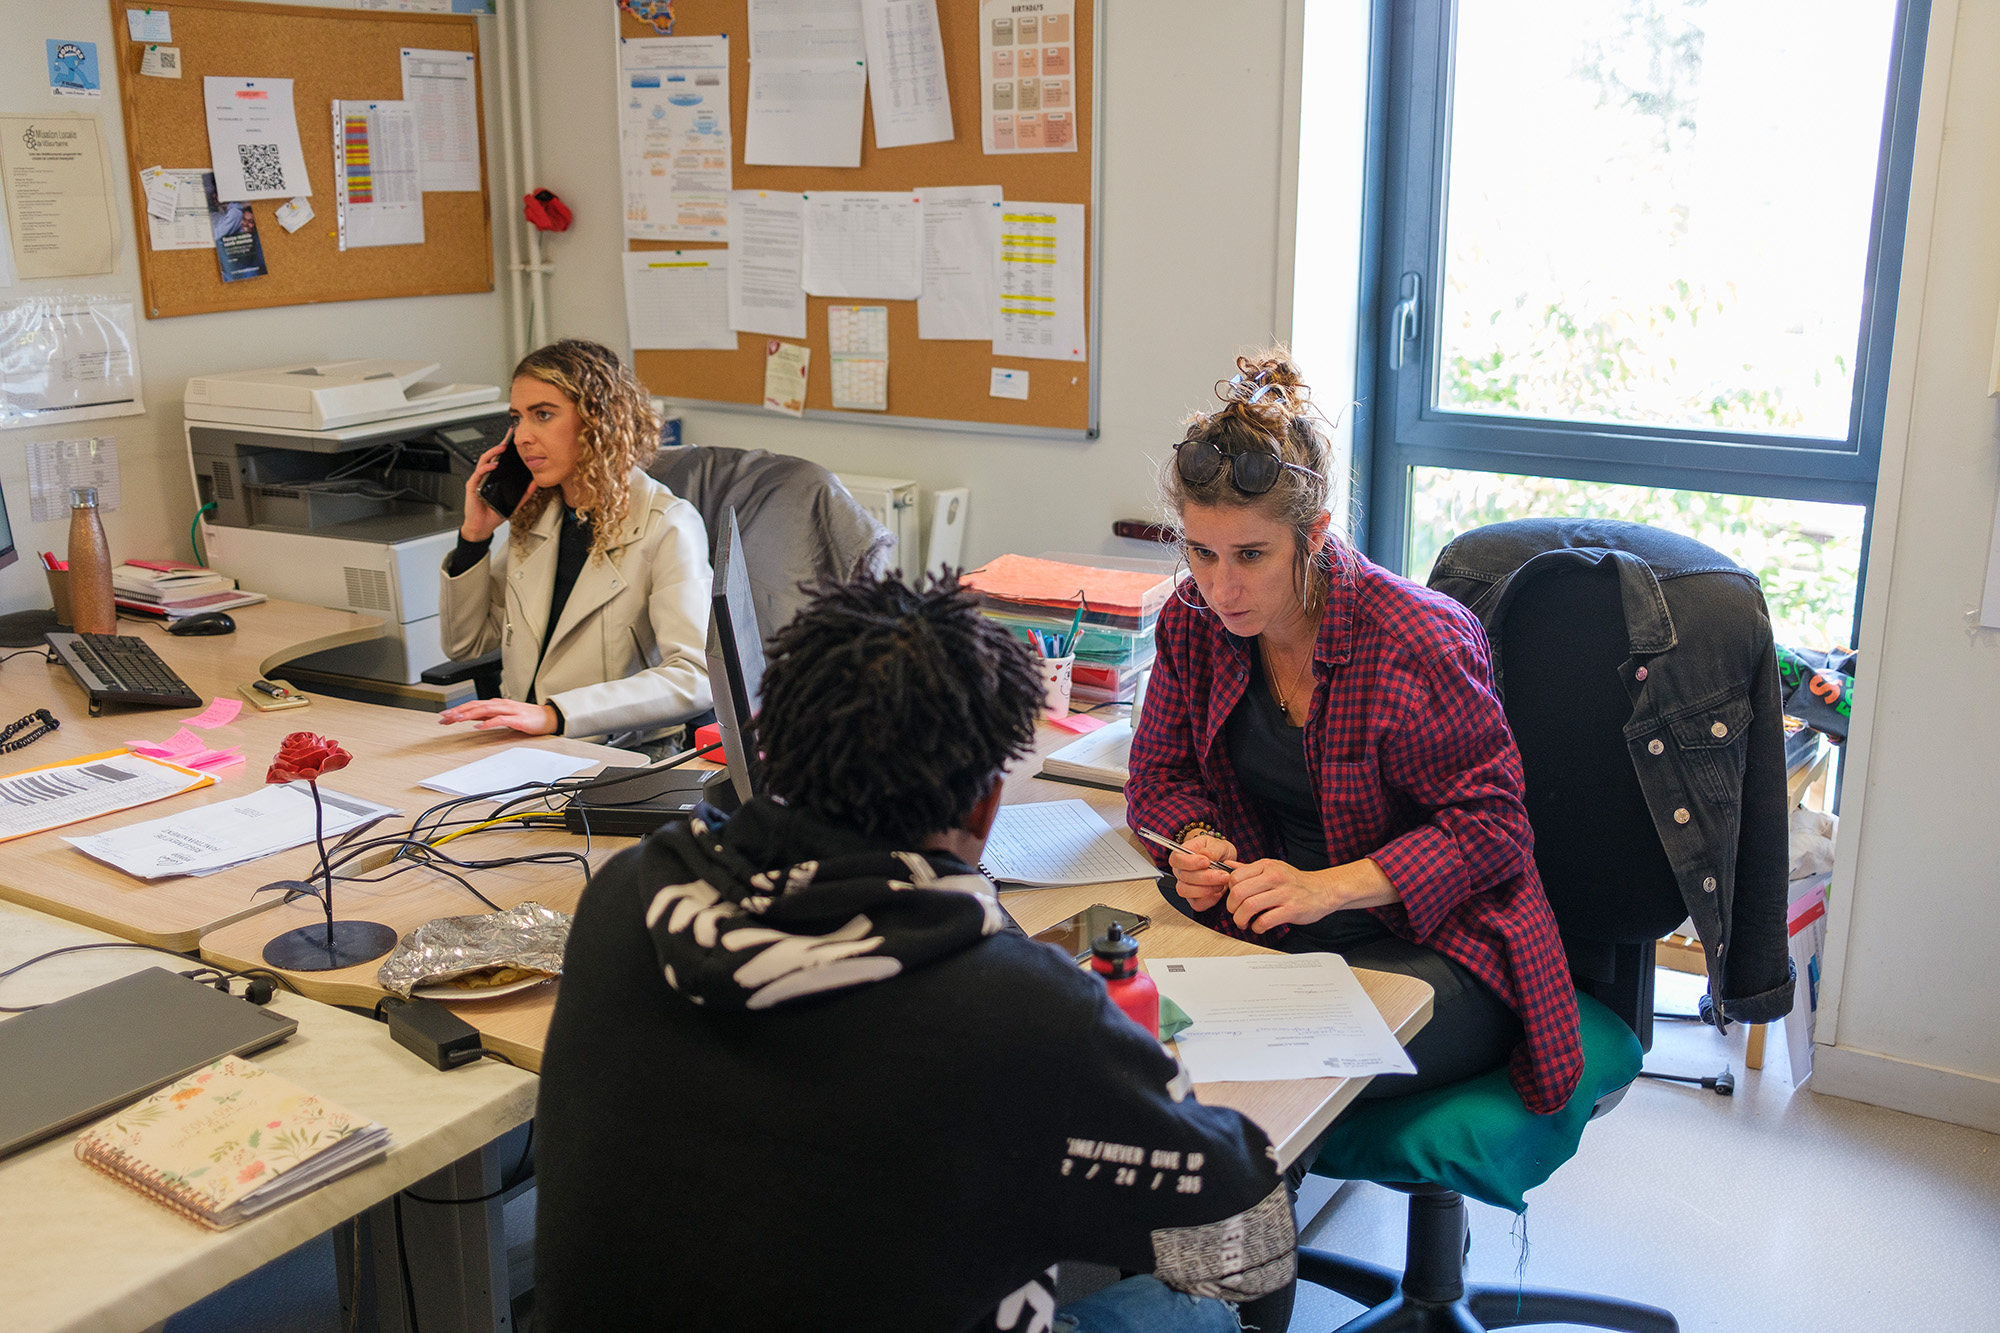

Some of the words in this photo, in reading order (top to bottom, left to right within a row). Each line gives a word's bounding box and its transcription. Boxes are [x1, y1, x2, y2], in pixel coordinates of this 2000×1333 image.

[1011, 4, 1044, 13] BIRTHDAYS
[35, 129, 58, 140] Mission
[59, 130, 77, 139] Locale
[1187, 1152, 1205, 1172] UP
